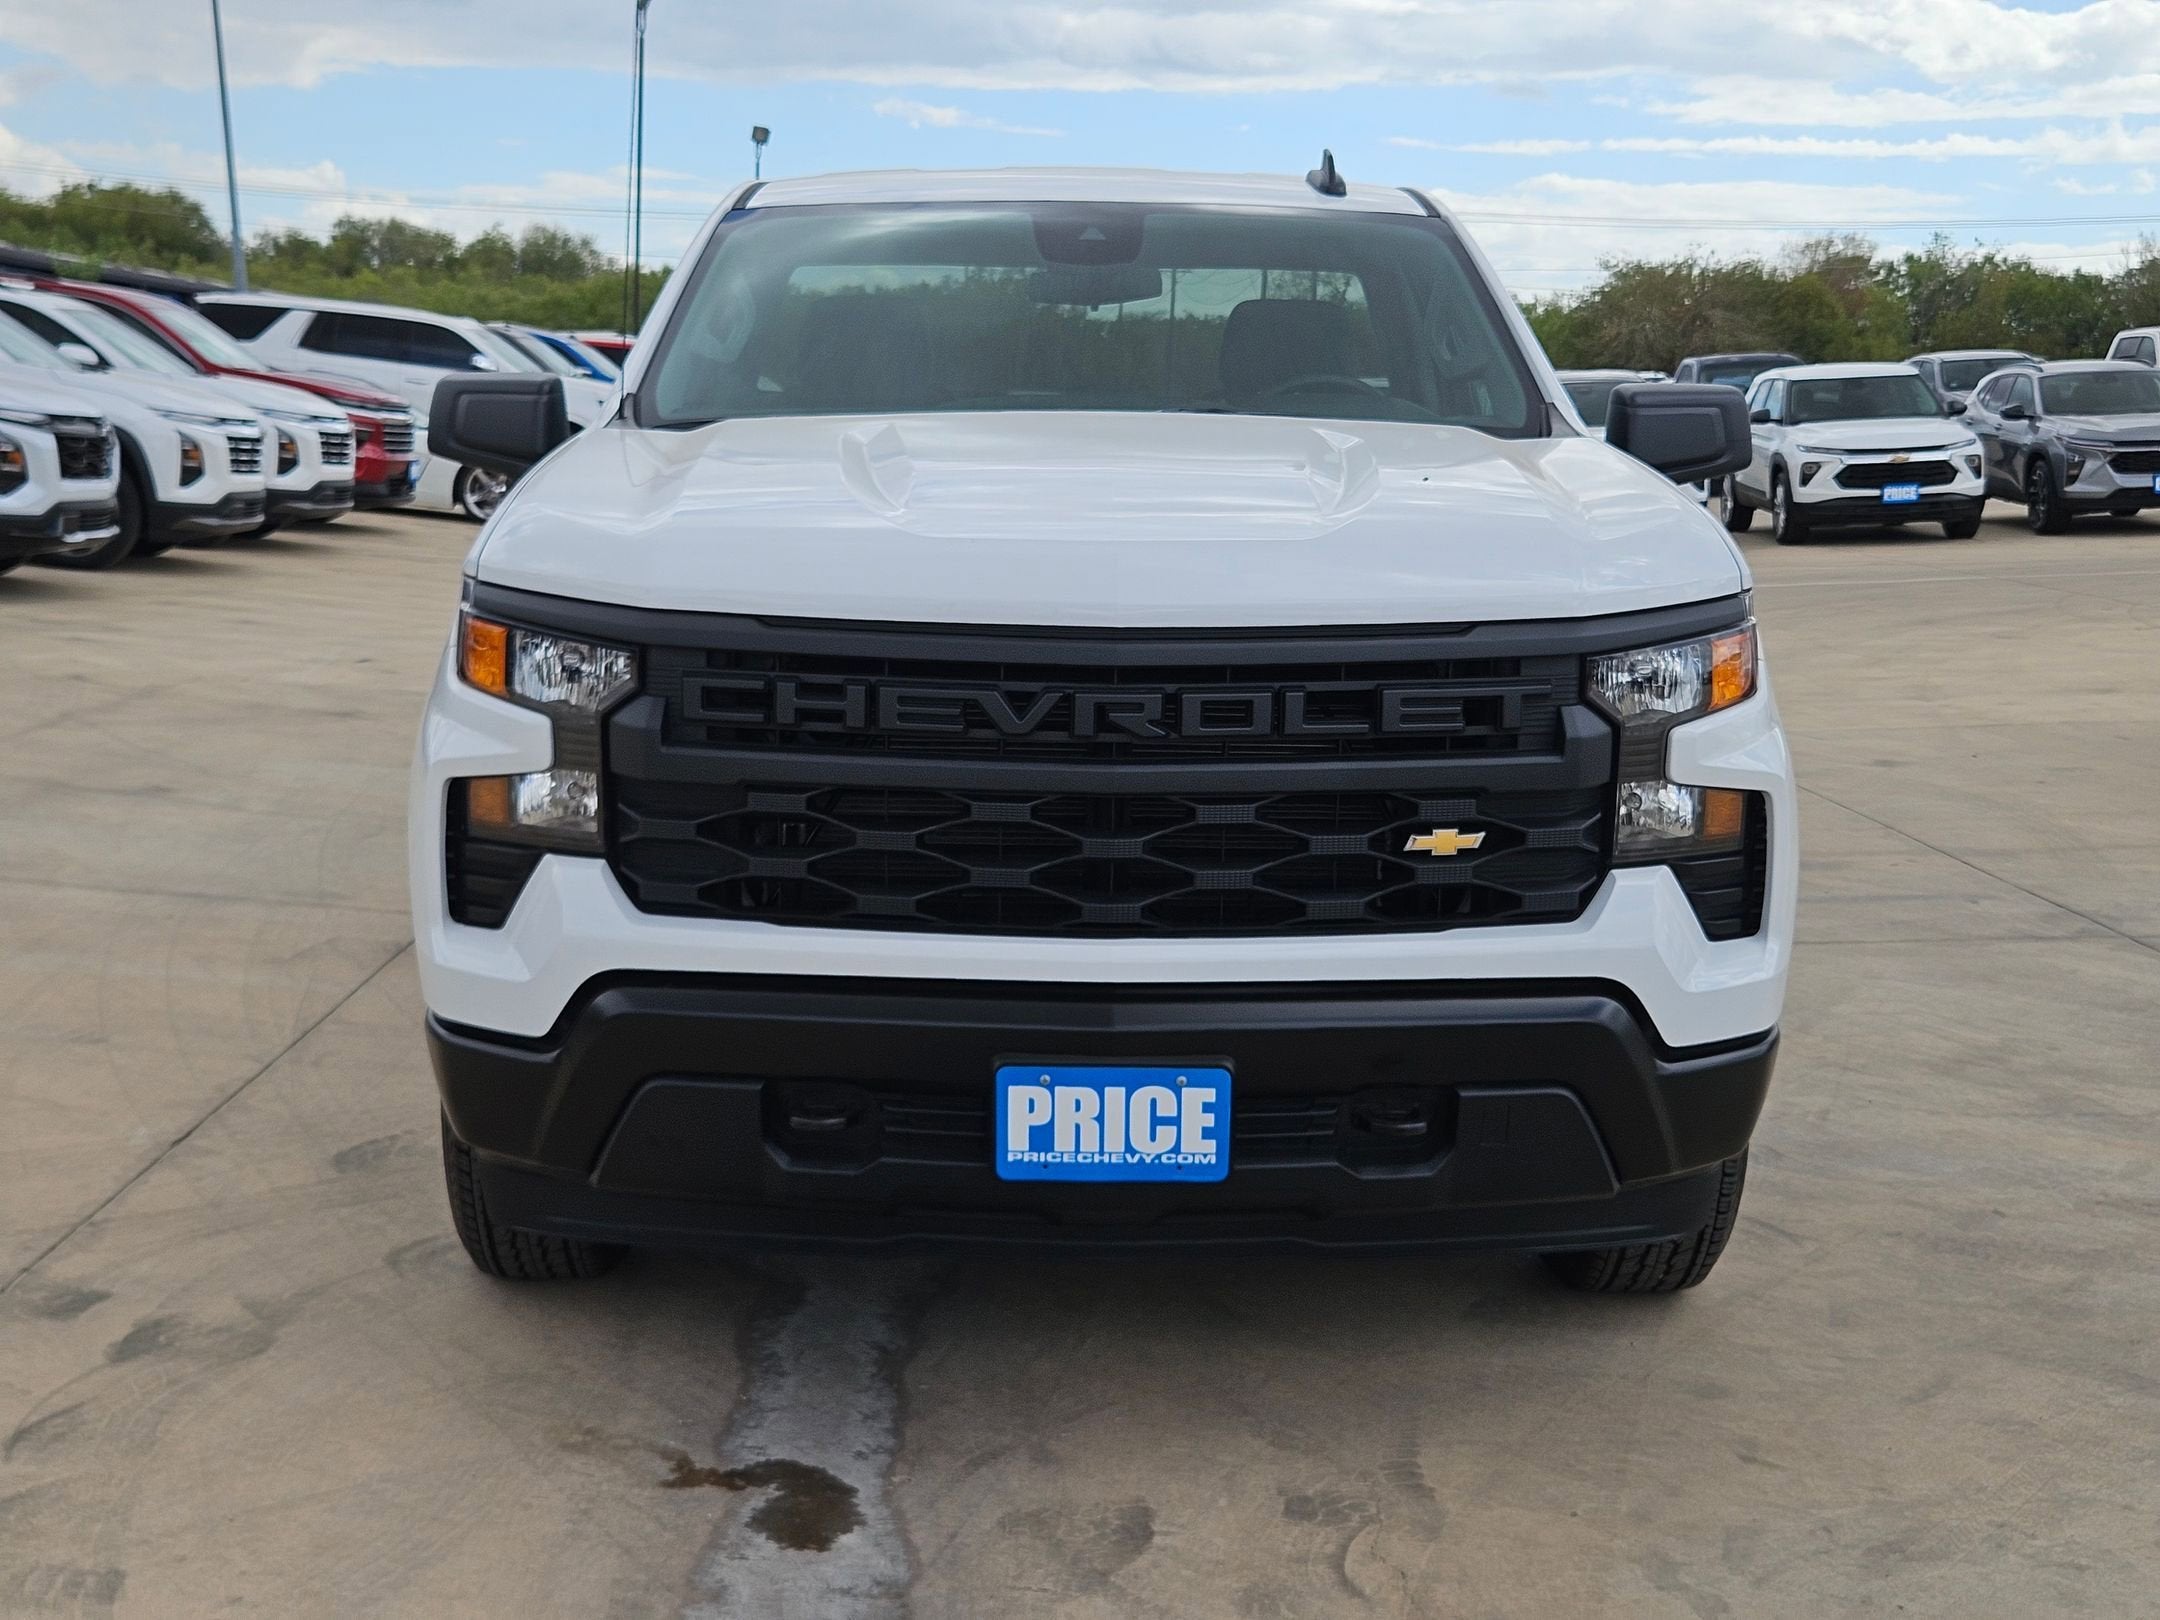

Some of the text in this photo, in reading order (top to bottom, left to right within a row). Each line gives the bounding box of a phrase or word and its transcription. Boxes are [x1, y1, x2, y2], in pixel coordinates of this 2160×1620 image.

[682, 676, 1553, 738] CHEVROLET
[1008, 1085, 1216, 1154] PRICE
[1008, 1152, 1216, 1164] PRICECHEVY.COM
